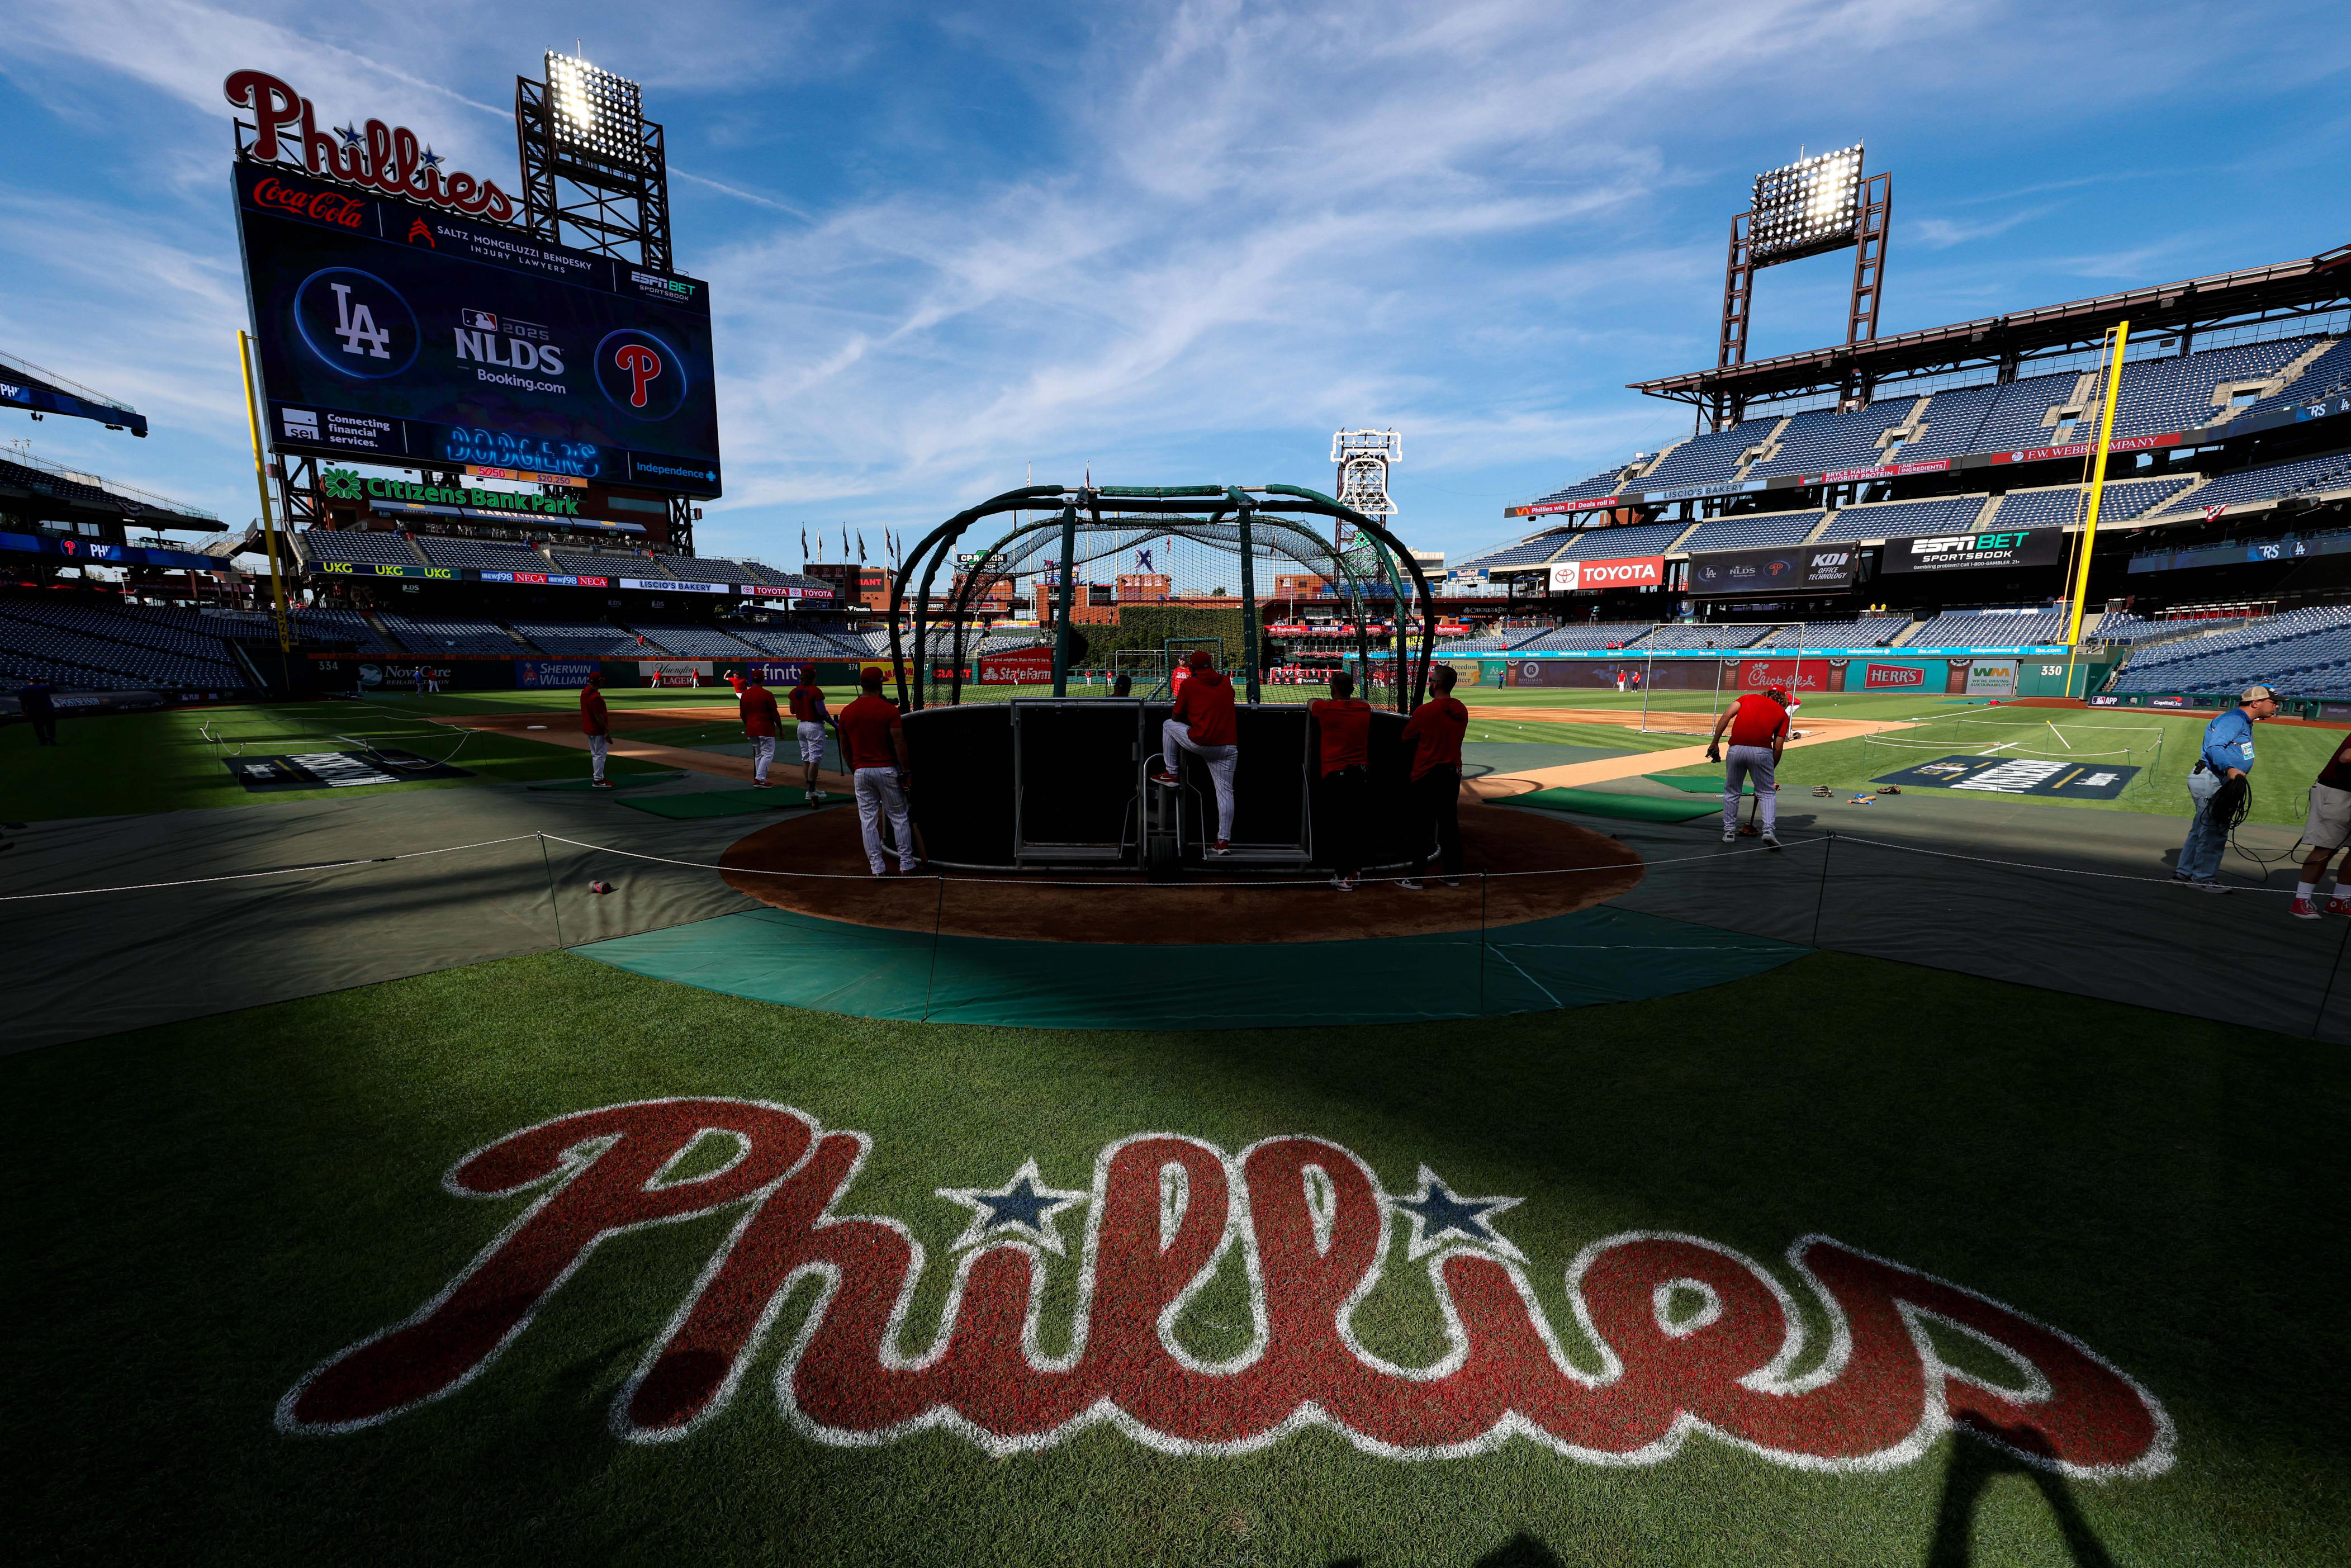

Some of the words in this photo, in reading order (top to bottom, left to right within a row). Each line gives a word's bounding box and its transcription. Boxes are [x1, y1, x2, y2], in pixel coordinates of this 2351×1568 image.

[224, 68, 514, 222] Phillies
[253, 177, 366, 228] Coca-Cola
[437, 226, 468, 240] SALTZ
[474, 234, 539, 257] MONGELUZZI
[544, 252, 592, 271] BENDESKY
[471, 245, 510, 260] INJURY
[519, 257, 566, 273] LAWYERS
[631, 271, 668, 289] ESPN
[669, 280, 695, 295] BET
[639, 285, 689, 301] SPORTSBOOK
[330, 282, 390, 359] LA
[503, 322, 549, 341] 2025
[454, 328, 566, 375] NLDS
[477, 368, 566, 394] Booking.com
[615, 344, 662, 408] P
[327, 414, 390, 431] Connecting
[328, 424, 376, 437] financial
[330, 434, 378, 447] services.
[2028, 449, 2049, 459] F.W.
[2053, 446, 2088, 456] WEBB
[2092, 437, 2158, 452] CMPANY
[637, 462, 704, 479] Independence
[1850, 466, 1885, 475] HARPER'S
[1861, 471, 1893, 479] PROTEIN
[1902, 465, 1942, 473] INGREDIENTS
[537, 474, 570, 485] $20,250
[367, 478, 467, 504] Citizens
[471, 487, 529, 510] Bank
[532, 493, 579, 515] Park
[1663, 489, 1704, 500] LISCIO'S
[1705, 482, 1744, 495] BAKERY
[476, 509, 518, 518] HARRY
[1911, 536, 1976, 553] ESPN
[1976, 532, 2030, 549] BET
[1810, 552, 1850, 567] KDI
[1922, 551, 2013, 562] SPORTSBOOK
[323, 562, 353, 573] UKG
[375, 565, 403, 576] UKG
[424, 568, 451, 578] UKG
[1583, 564, 1655, 582] TOYOTA
[516, 574, 546, 583] NECA
[580, 577, 607, 586] NECA
[1808, 572, 1847, 580] TECHNOLOGY
[639, 580, 675, 590] LISCIO'S
[679, 581, 711, 592] BAKERY
[756, 587, 787, 595] TOYOTA
[319, 661, 338, 670] 334
[540, 664, 591, 674] SHERWIN
[1973, 668, 2010, 676] WM
[2041, 666, 2062, 676] 330
[1871, 670, 1917, 683] HERR'S
[274, 1094, 2177, 1481] Phillies
